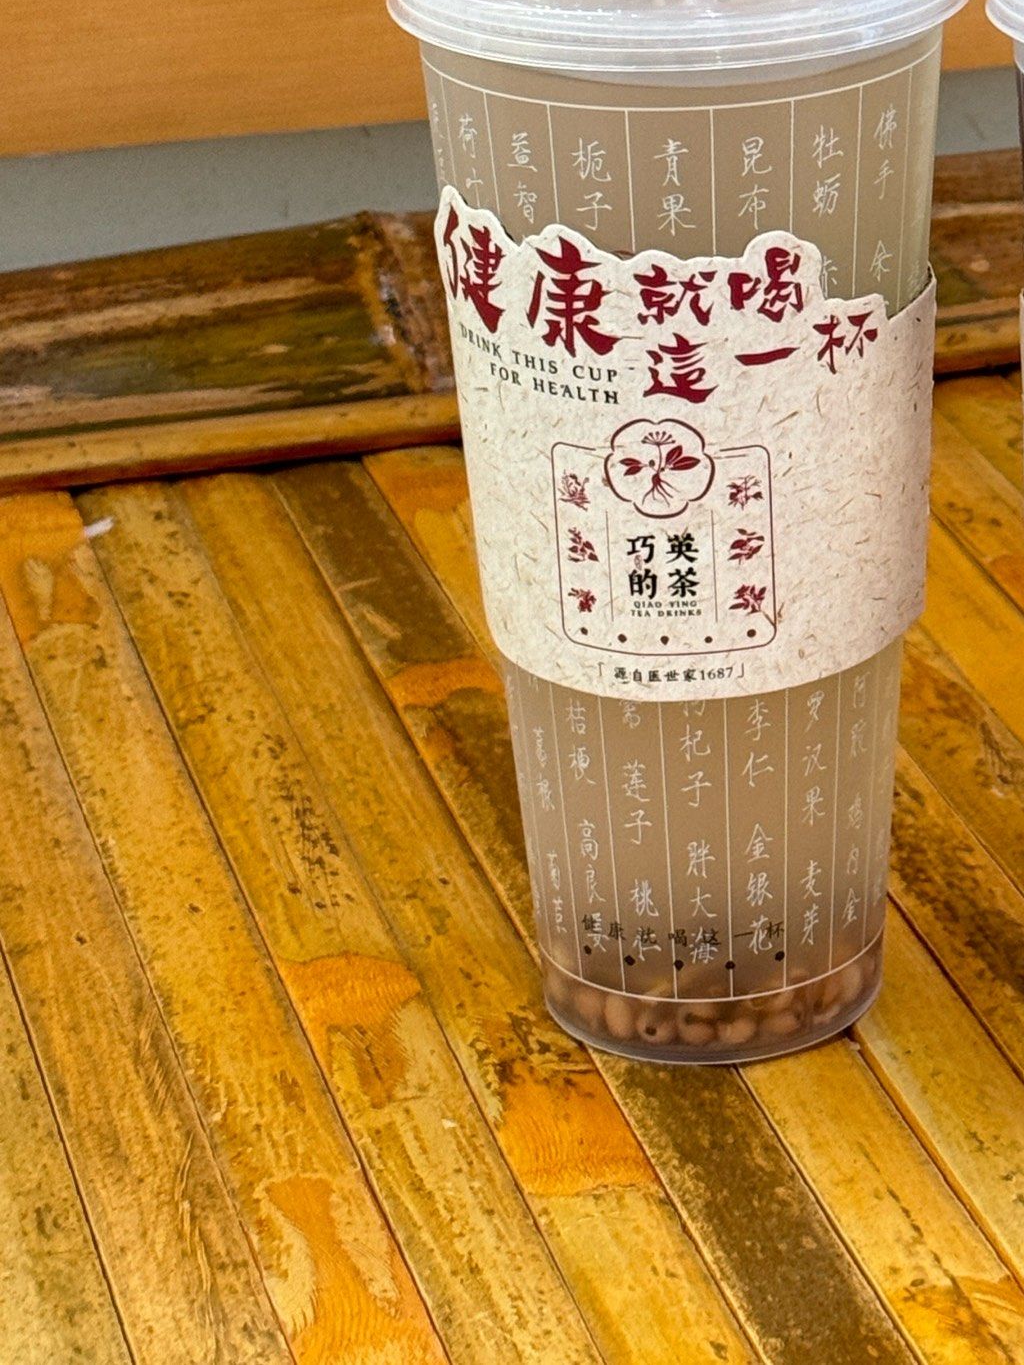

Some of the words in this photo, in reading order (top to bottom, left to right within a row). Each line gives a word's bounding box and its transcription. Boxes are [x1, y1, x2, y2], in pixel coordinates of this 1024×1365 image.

[572, 138, 613, 231] 栀子
[653, 138, 696, 235] 青果
[738, 137, 774, 230] 昆布
[441, 205, 804, 358] 健康就喝
[459, 322, 502, 358] DRINK
[511, 349, 559, 376] THIS
[571, 364, 619, 383] CUP
[489, 362, 523, 388] FOR
[532, 378, 620, 405] HEALTH
[643, 310, 879, 404] 這一杯
[620, 758, 652, 846] 莲子
